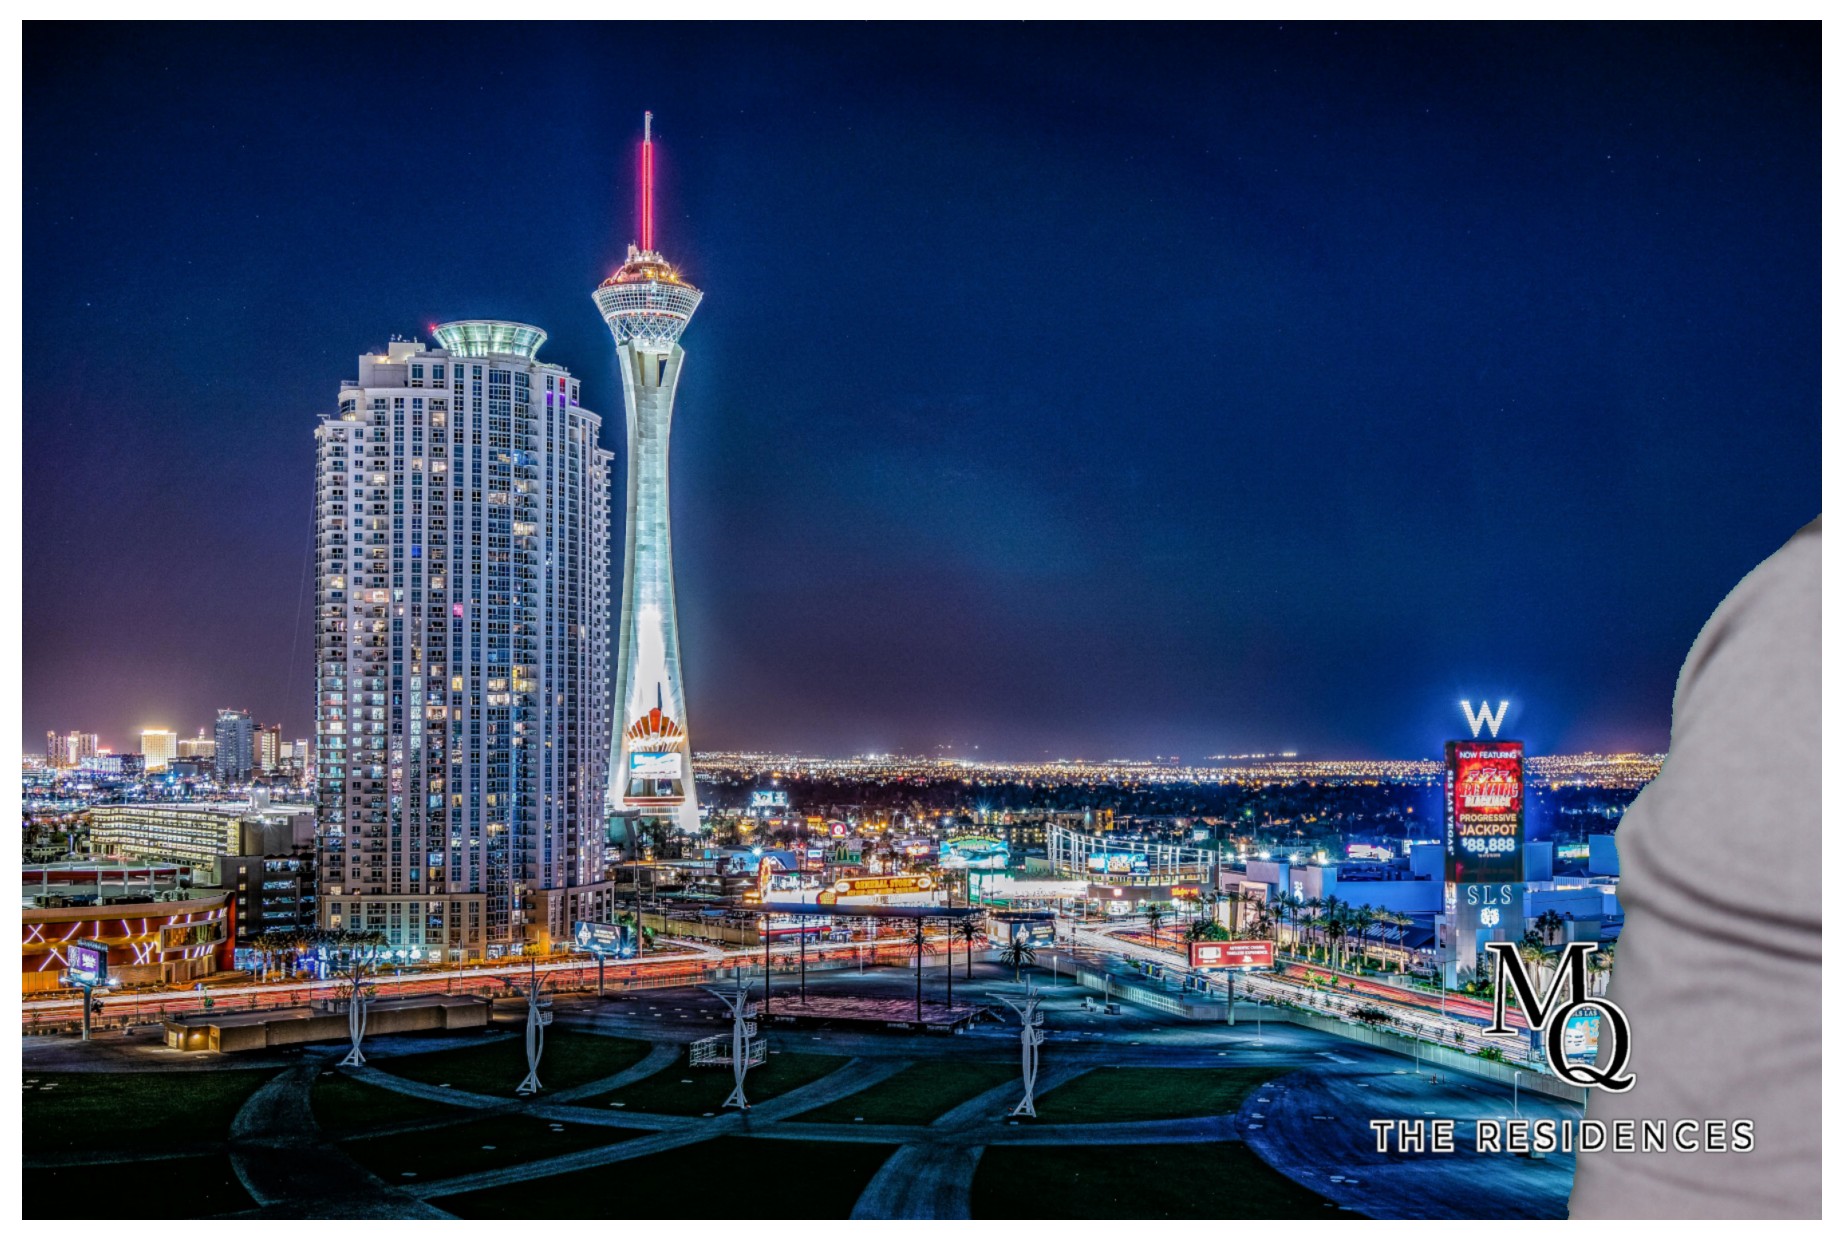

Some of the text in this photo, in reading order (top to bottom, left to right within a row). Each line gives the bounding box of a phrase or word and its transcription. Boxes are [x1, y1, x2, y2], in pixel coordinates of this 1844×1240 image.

[1461, 700, 1509, 738] W
[1459, 751, 1517, 759] NOW FEATURING
[1459, 813, 1517, 822] PROGRESSIVE
[1459, 824, 1517, 836] JACKPOT
[1462, 837, 1515, 853] $88,888
[1467, 885, 1513, 905] SLS
